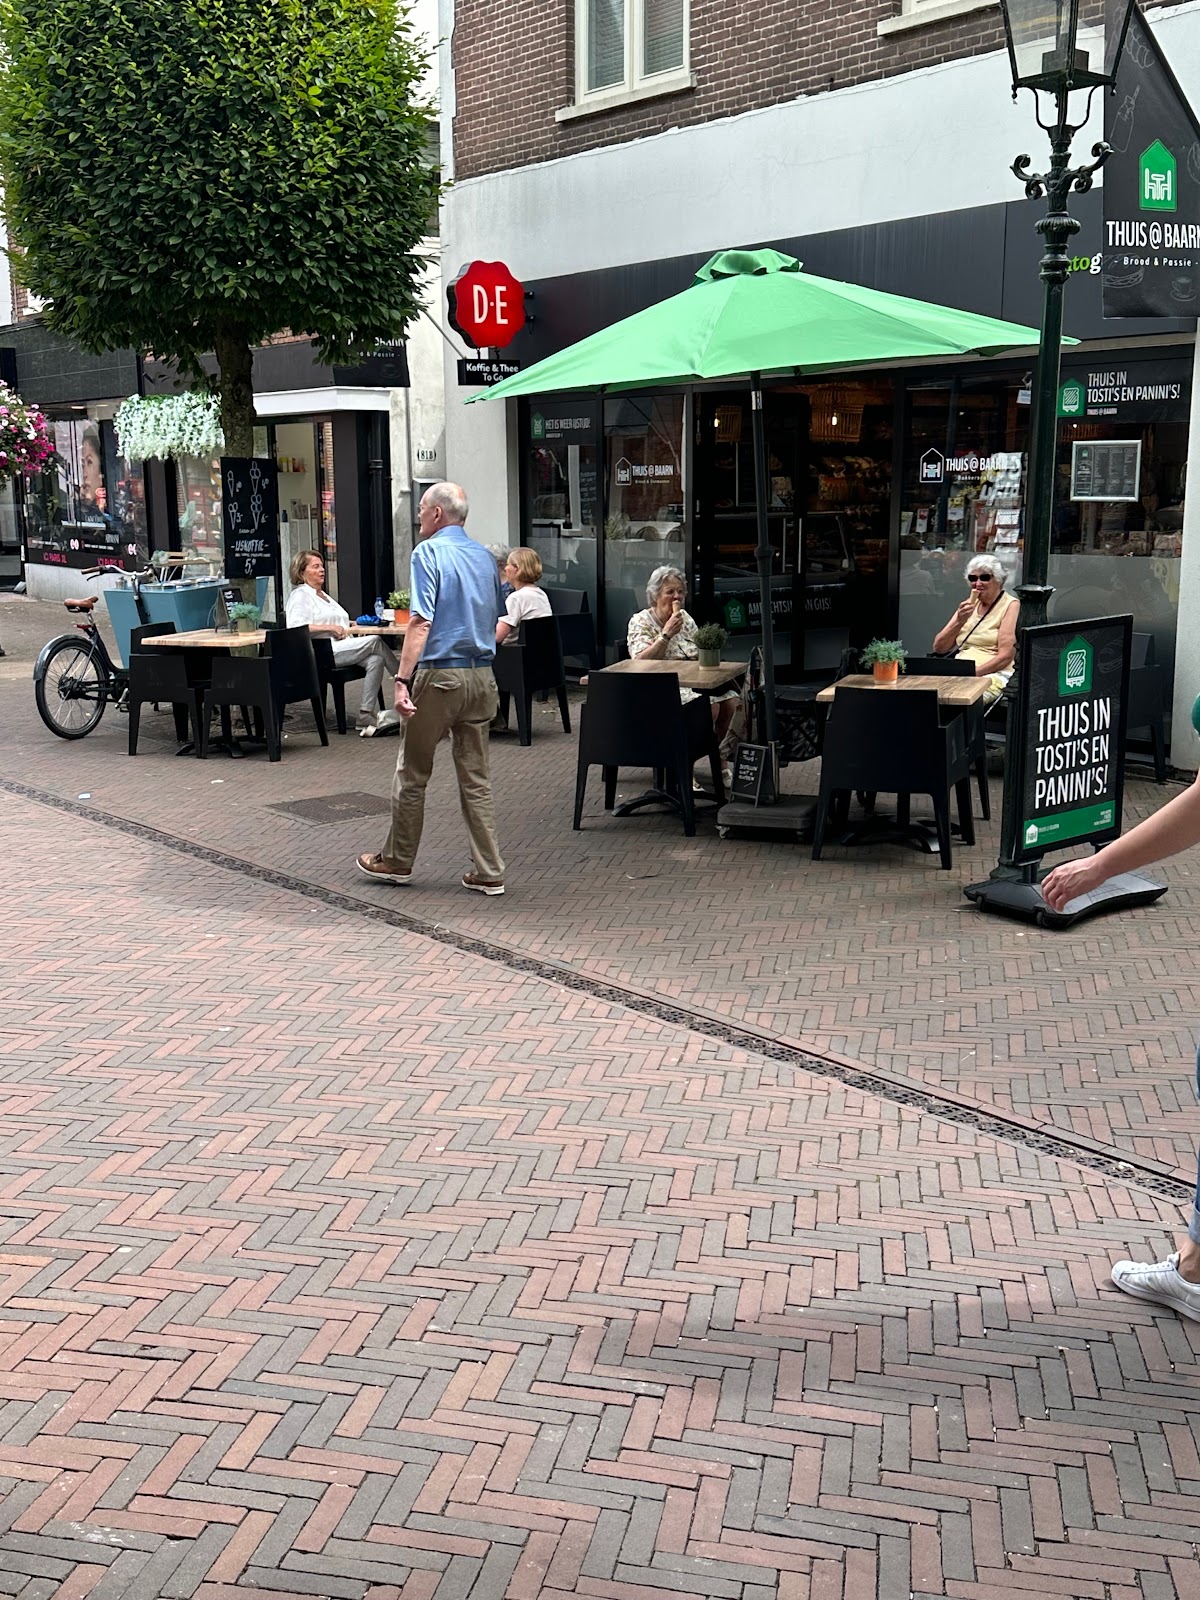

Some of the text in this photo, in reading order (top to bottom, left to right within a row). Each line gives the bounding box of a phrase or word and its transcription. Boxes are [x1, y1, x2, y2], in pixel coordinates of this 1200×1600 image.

[1106, 221, 1147, 247] THUIS
[1149, 222, 1162, 250] @
[1123, 257, 1192, 267] Brood & Passie
[466, 363, 519, 373] Koffie & Thee
[482, 373, 504, 381] To Go
[1088, 371, 1127, 387] THUIS IN
[1087, 384, 1181, 403] TOSTI'S EN PANINI'S!
[545, 419, 554, 429] HET
[632, 465, 674, 477] THUIS @ BAARN
[945, 457, 969, 472] THUIS
[969, 457, 979, 472] @
[1037, 697, 1111, 742] THUIS IN
[1036, 734, 1110, 775] TOSTI'S EN
[1035, 764, 1109, 809] PANINI'S!
